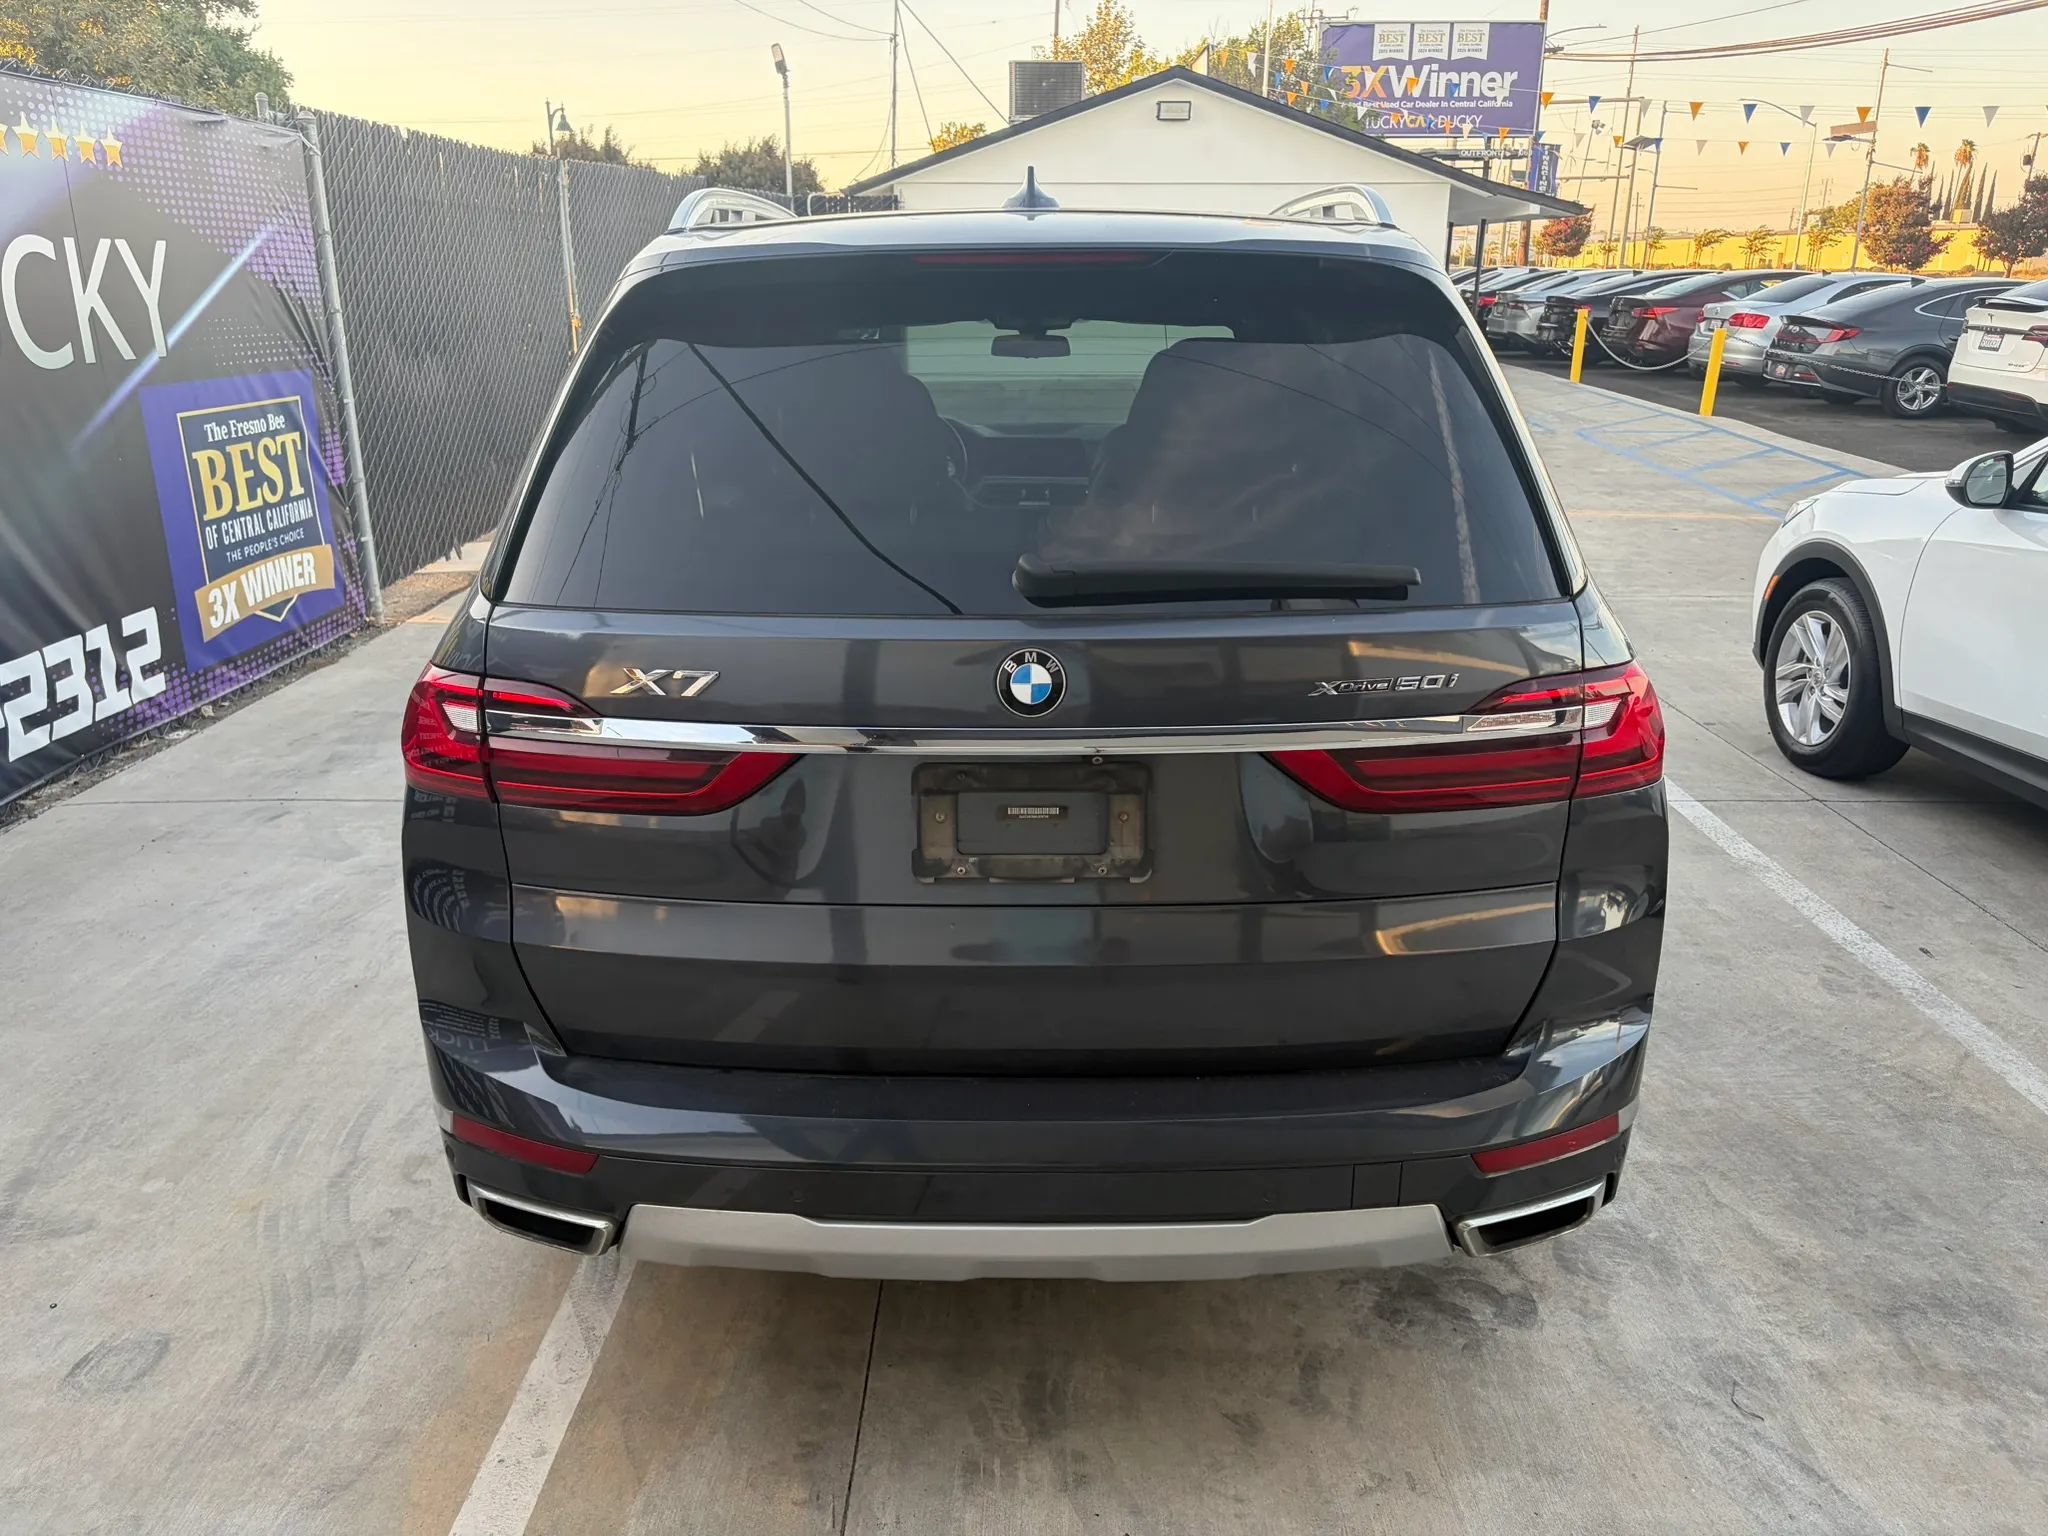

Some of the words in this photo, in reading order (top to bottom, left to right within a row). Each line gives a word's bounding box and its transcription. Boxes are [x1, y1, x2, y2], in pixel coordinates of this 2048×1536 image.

[1378, 33, 1406, 44] BEST
[1417, 32, 1446, 43] BEST
[1457, 32, 1485, 43] BEST
[1387, 64, 1518, 98] Winner
[1381, 101, 1399, 109] Used
[1415, 100, 1440, 108] Dealer
[1450, 100, 1476, 108] Central
[1477, 100, 1513, 108] Califonia
[1437, 114, 1483, 129] DUCKY
[1, 234, 167, 370] CKY
[204, 421, 229, 442] The
[228, 418, 267, 438] Fresno
[266, 413, 285, 431] Bee
[192, 431, 305, 521] BEST
[205, 525, 218, 550] OF
[221, 514, 266, 545] CENTRAL
[266, 497, 314, 531] CALIFORNIA
[226, 551, 242, 563] THE
[244, 537, 278, 557] PEOPLE'S
[279, 527, 305, 546] CHOICE
[207, 581, 240, 629] 3X
[240, 552, 316, 607] WINNER
[1003, 651, 1059, 673] BMW
[0, 606, 166, 763] 2312
[610, 667, 719, 697] X7
[1395, 673, 1460, 691] 50i
